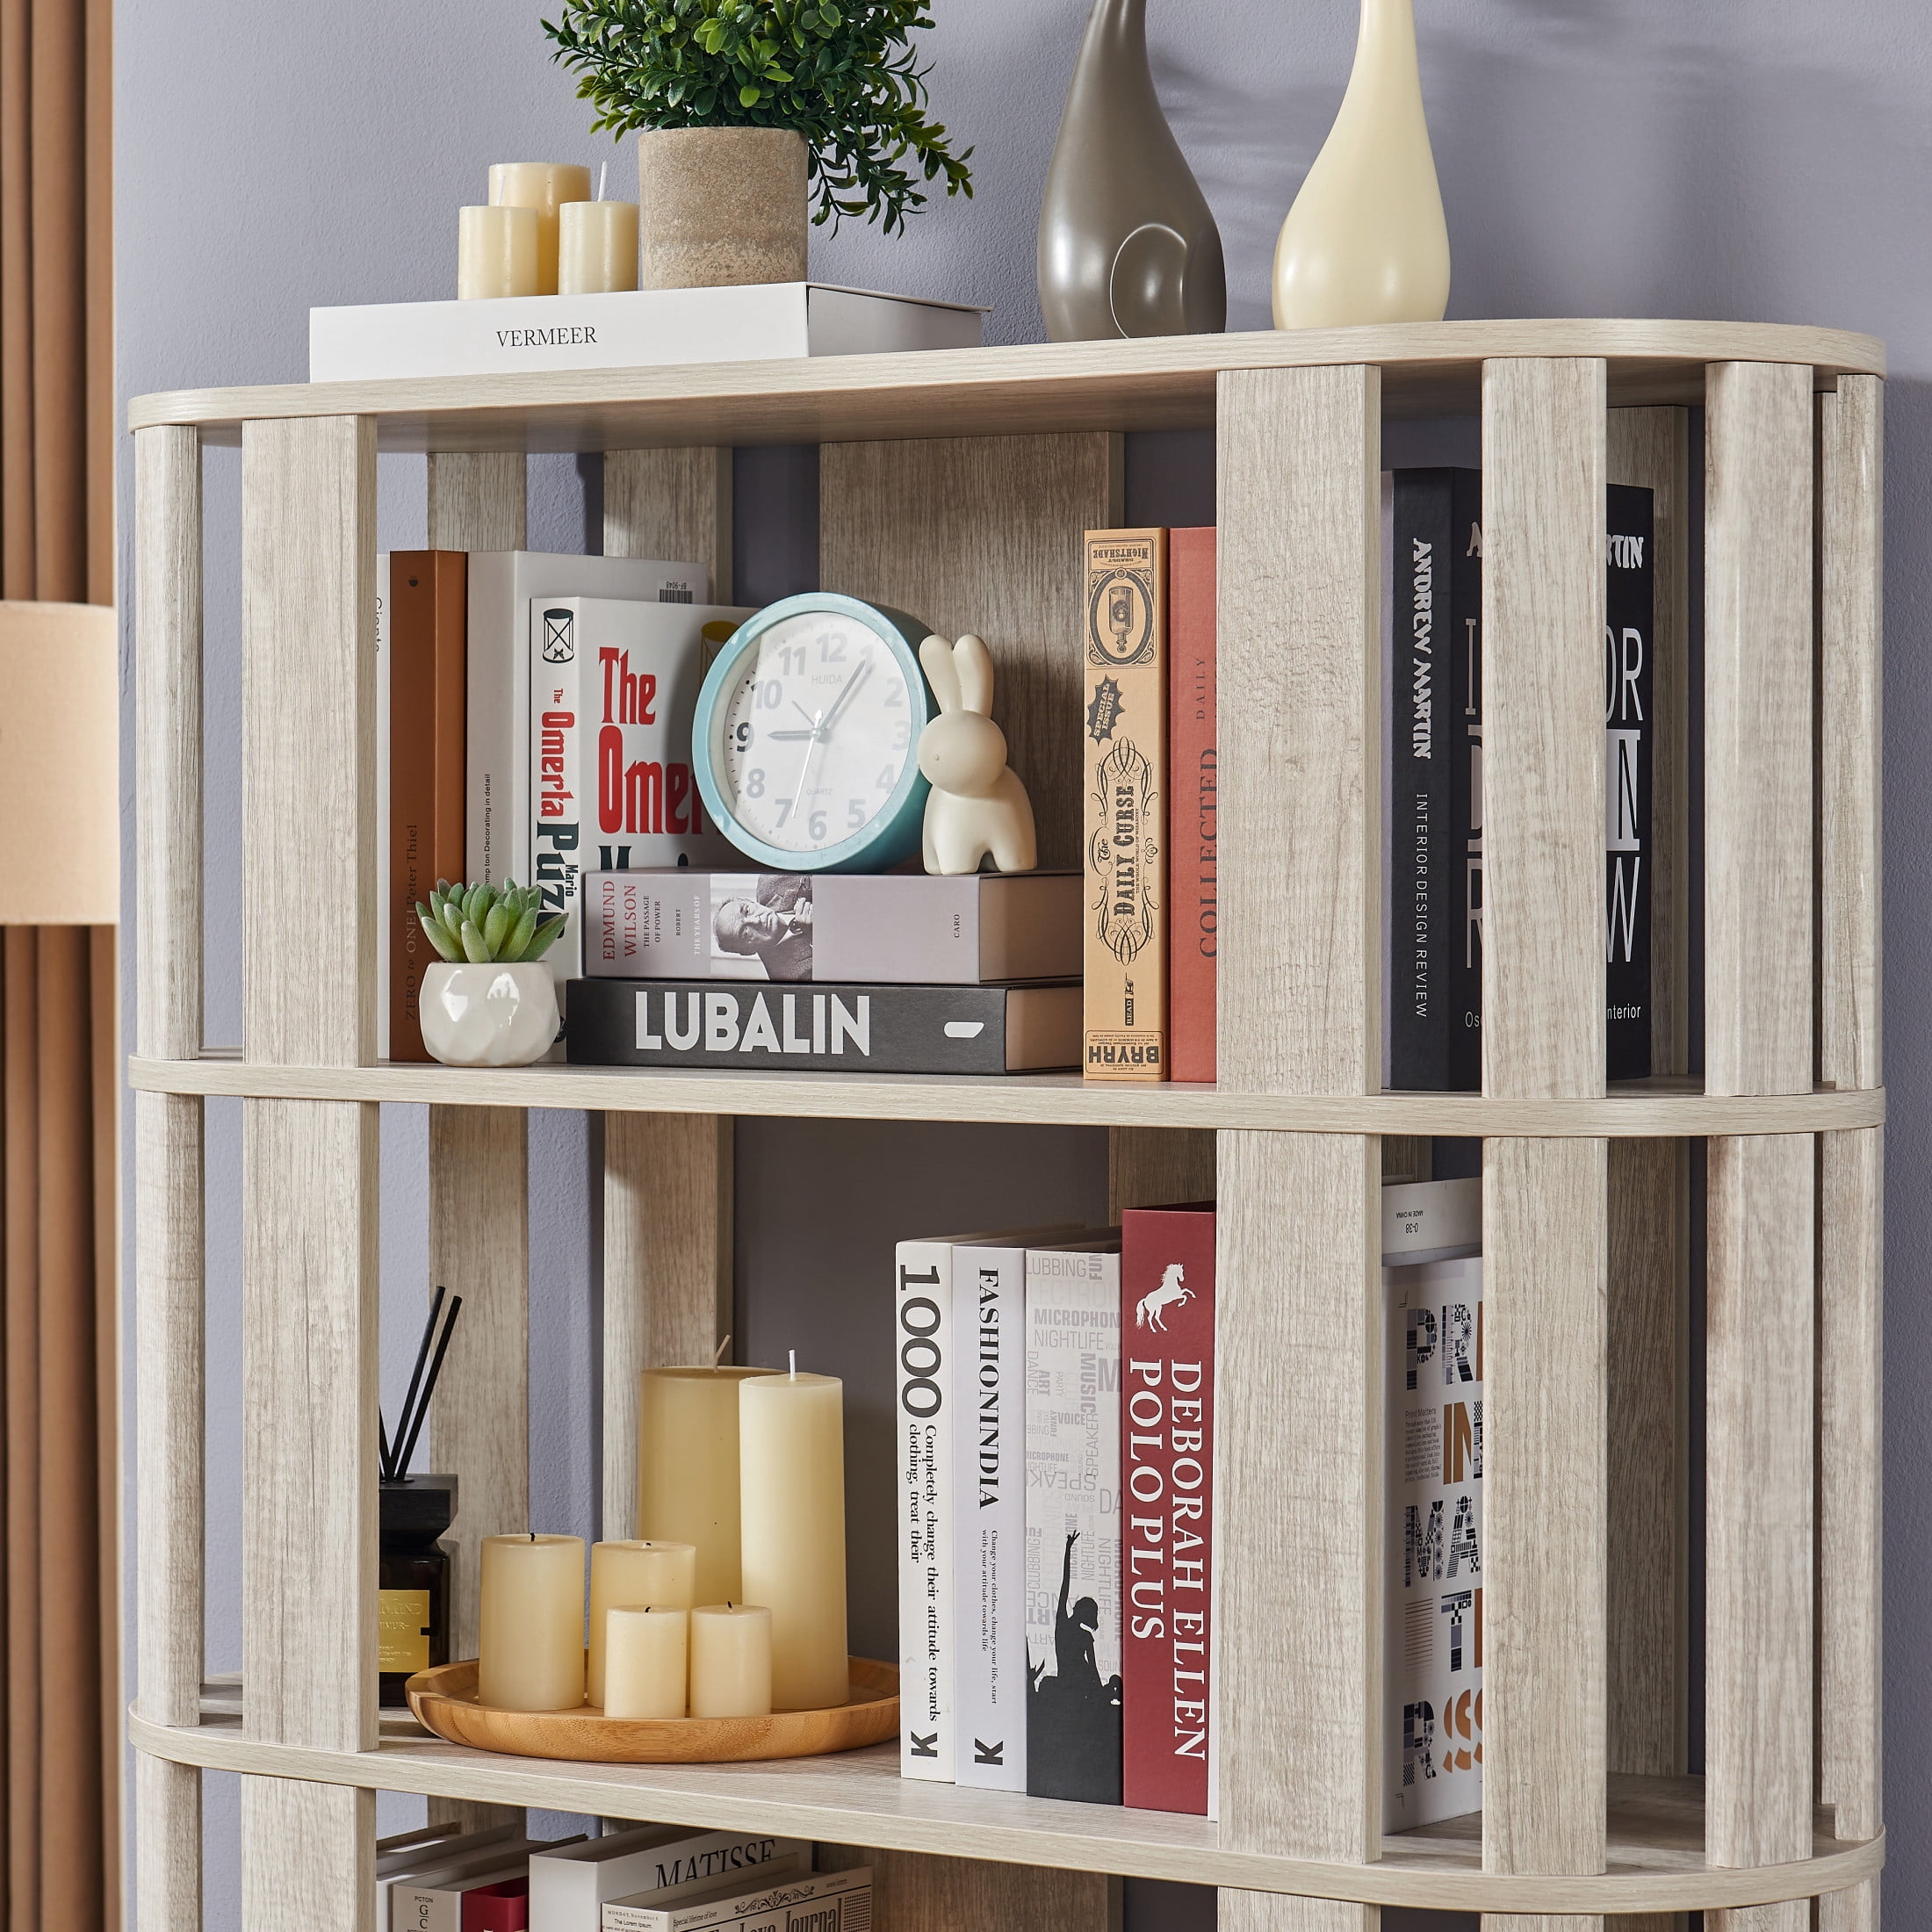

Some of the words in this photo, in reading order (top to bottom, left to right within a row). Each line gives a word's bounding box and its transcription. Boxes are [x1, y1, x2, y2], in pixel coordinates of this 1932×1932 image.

[496, 326, 598, 348] VERMEER
[1606, 534, 1644, 569] TIN
[1413, 537, 1432, 654] ANDREW
[777, 645, 807, 676] 11
[815, 632, 847, 663] 12
[553, 688, 564, 704] The
[598, 646, 657, 726] The
[750, 679, 783, 710] 10
[811, 674, 843, 686] HUIDA
[883, 677, 904, 708] 2
[1196, 658, 1206, 720] DAILY
[1093, 683, 1111, 737] SPECIAL
[1101, 692, 1115, 730] ISSUE
[1413, 658, 1432, 760] MARTIN
[736, 722, 754, 753] 9
[891, 721, 912, 751] 3
[541, 710, 575, 817] Omerta
[875, 764, 896, 794] 4
[746, 768, 766, 798] 8
[775, 799, 794, 829] 7
[808, 810, 827, 841] 6
[847, 798, 867, 829] 5
[1113, 785, 1135, 847] CURSE
[406, 824, 417, 863] Thiel
[1098, 838, 1111, 863] The
[1416, 793, 1428, 875] INTERIOR
[406, 867, 417, 905] Peter
[565, 863, 579, 898] Mario
[1113, 854, 1135, 916] DAILY
[694, 894, 701, 907] OF
[1416, 880, 1428, 943] DESIGN
[406, 917, 417, 954] ONE
[602, 881, 615, 961] EDMUND
[624, 884, 637, 957] WILSON
[654, 932, 661, 943] OF
[405, 976, 417, 1020] ZERO
[1416, 949, 1428, 1018] REVIEW
[634, 991, 871, 1056] LUBALIN
[1607, 1003, 1641, 1020] nterior
[899, 1264, 942, 1418] 1000
[1034, 1329, 1104, 1351] NIGHTLIFE
[978, 1267, 999, 1510] FASHIONINDIA
[1027, 1351, 1039, 1396] DANCE
[1038, 1369, 1050, 1397] ART
[1080, 1352, 1097, 1414] MUSIC
[1057, 1411, 1086, 1426] VOICE
[1129, 1358, 1164, 1503] POLO
[1405, 1409, 1417, 1418] Print
[1417, 1408, 1437, 1417] Matters
[906, 1424, 922, 1485] clothing,
[1085, 1410, 1099, 1477] SPEAKER
[921, 1424, 938, 1505] Completely
[1171, 1359, 1205, 1593] DEBORAH
[910, 1490, 922, 1524] treat
[1064, 1493, 1096, 1503] SOUND
[910, 1531, 923, 1563] their
[923, 1510, 939, 1561] change
[990, 1530, 998, 1561] Change
[1027, 1538, 1041, 1590] CLUBBING
[1081, 1531, 1095, 1581] NIGHTLIFE
[926, 1567, 941, 1601] their
[1098, 1538, 1112, 1616] NIGHTLIFE
[1130, 1514, 1165, 1640] PLUS
[990, 1582, 998, 1615] clothes,
[927, 1605, 941, 1661] attitude
[990, 1616, 998, 1645] change
[928, 1667, 941, 1721] towards
[990, 1668, 998, 1683] life,
[1173, 1608, 1207, 1761] ELLEN
[910, 1730, 939, 1758] K
[974, 1737, 1004, 1766] K
[655, 1838, 776, 1889] MATISSE
[419, 1904, 429, 1915] G
[419, 1918, 429, 1929] C
